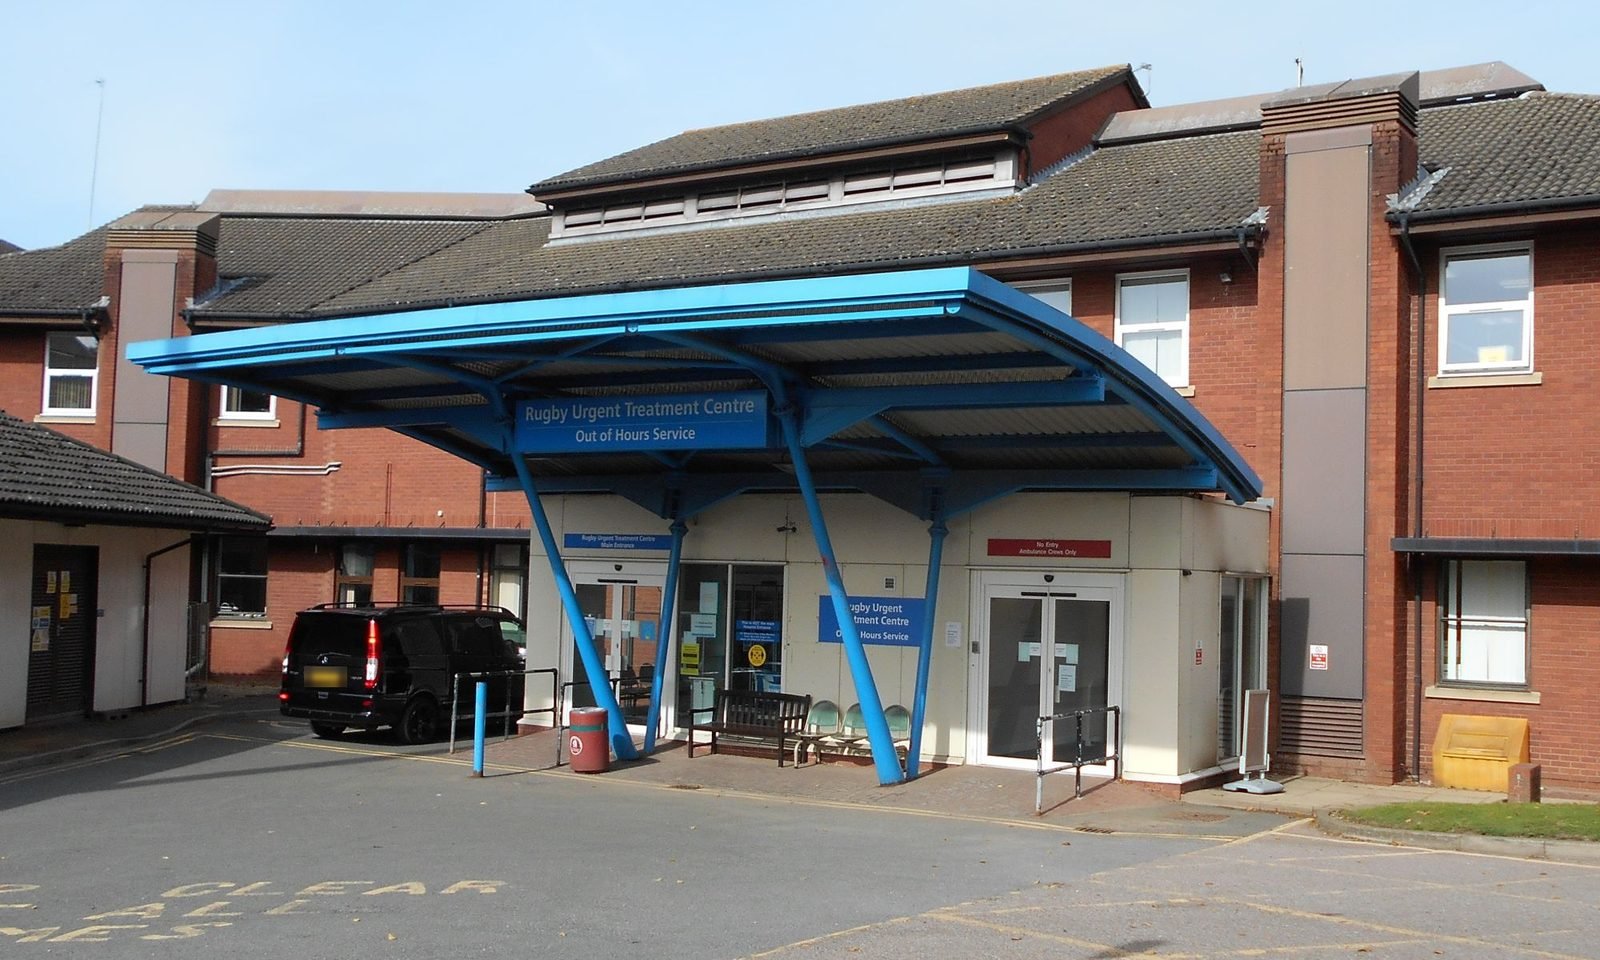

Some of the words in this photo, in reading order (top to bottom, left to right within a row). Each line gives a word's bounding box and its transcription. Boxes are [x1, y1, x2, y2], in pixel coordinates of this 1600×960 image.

[525, 406, 568, 425] Rugby
[572, 403, 621, 423] Urgent
[625, 400, 700, 418] Treatment
[703, 398, 755, 414] Centre
[575, 429, 597, 442] Out
[599, 428, 612, 442] of
[615, 428, 650, 441] Hours
[653, 427, 696, 441] Service
[582, 534, 597, 542] Rugby
[1045, 541, 1059, 549] Entry
[849, 602, 871, 614] ugby
[872, 603, 903, 614] Urgent
[853, 616, 879, 625] tment
[880, 616, 910, 626] Centre
[860, 631, 881, 640] Hours
[883, 632, 910, 641] Service
[160, 880, 507, 898] CLEAR
